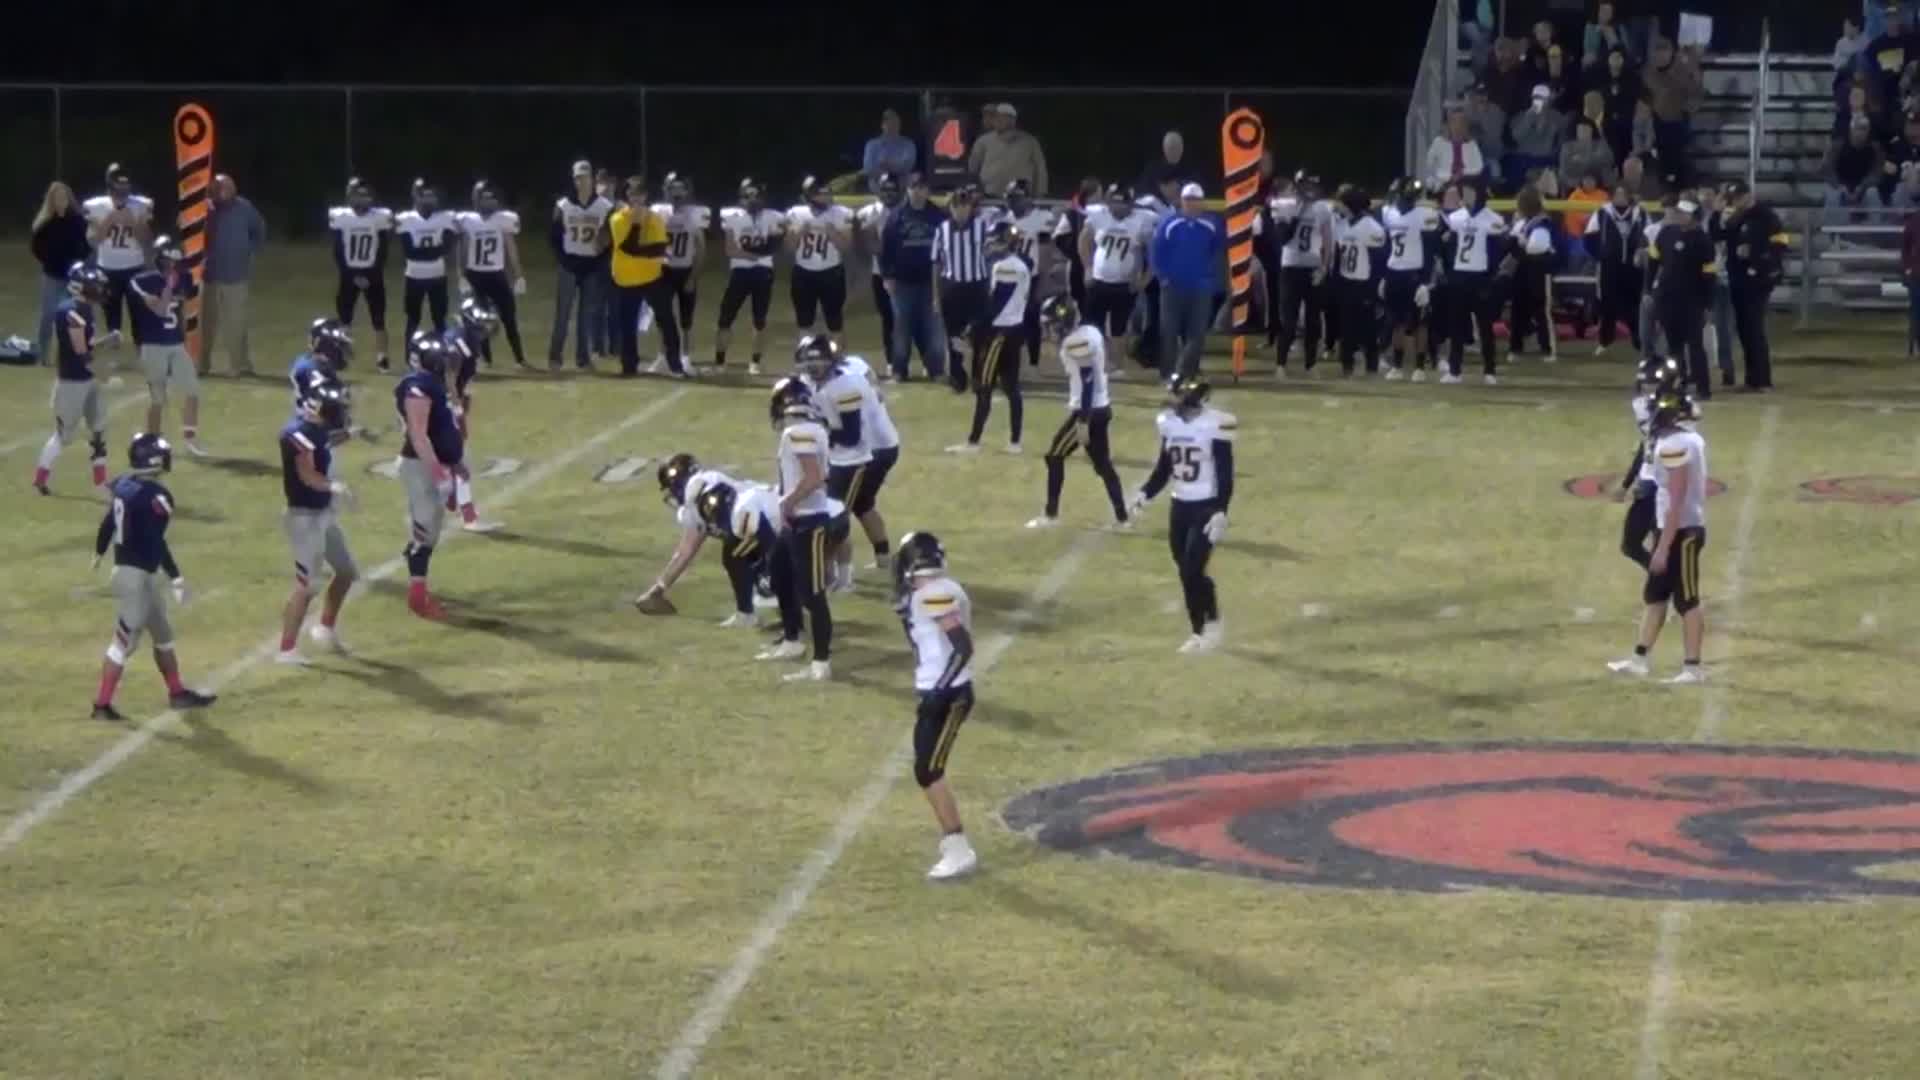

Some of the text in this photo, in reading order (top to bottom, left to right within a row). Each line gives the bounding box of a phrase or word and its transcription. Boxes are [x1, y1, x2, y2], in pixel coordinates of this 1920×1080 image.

[933, 119, 965, 159] 4
[350, 233, 372, 261] 10
[475, 237, 496, 266] 12
[802, 232, 828, 260] 64
[1102, 235, 1131, 261] 77
[1460, 232, 1476, 264] 2
[163, 301, 179, 330] 5
[1166, 445, 1202, 482] 25
